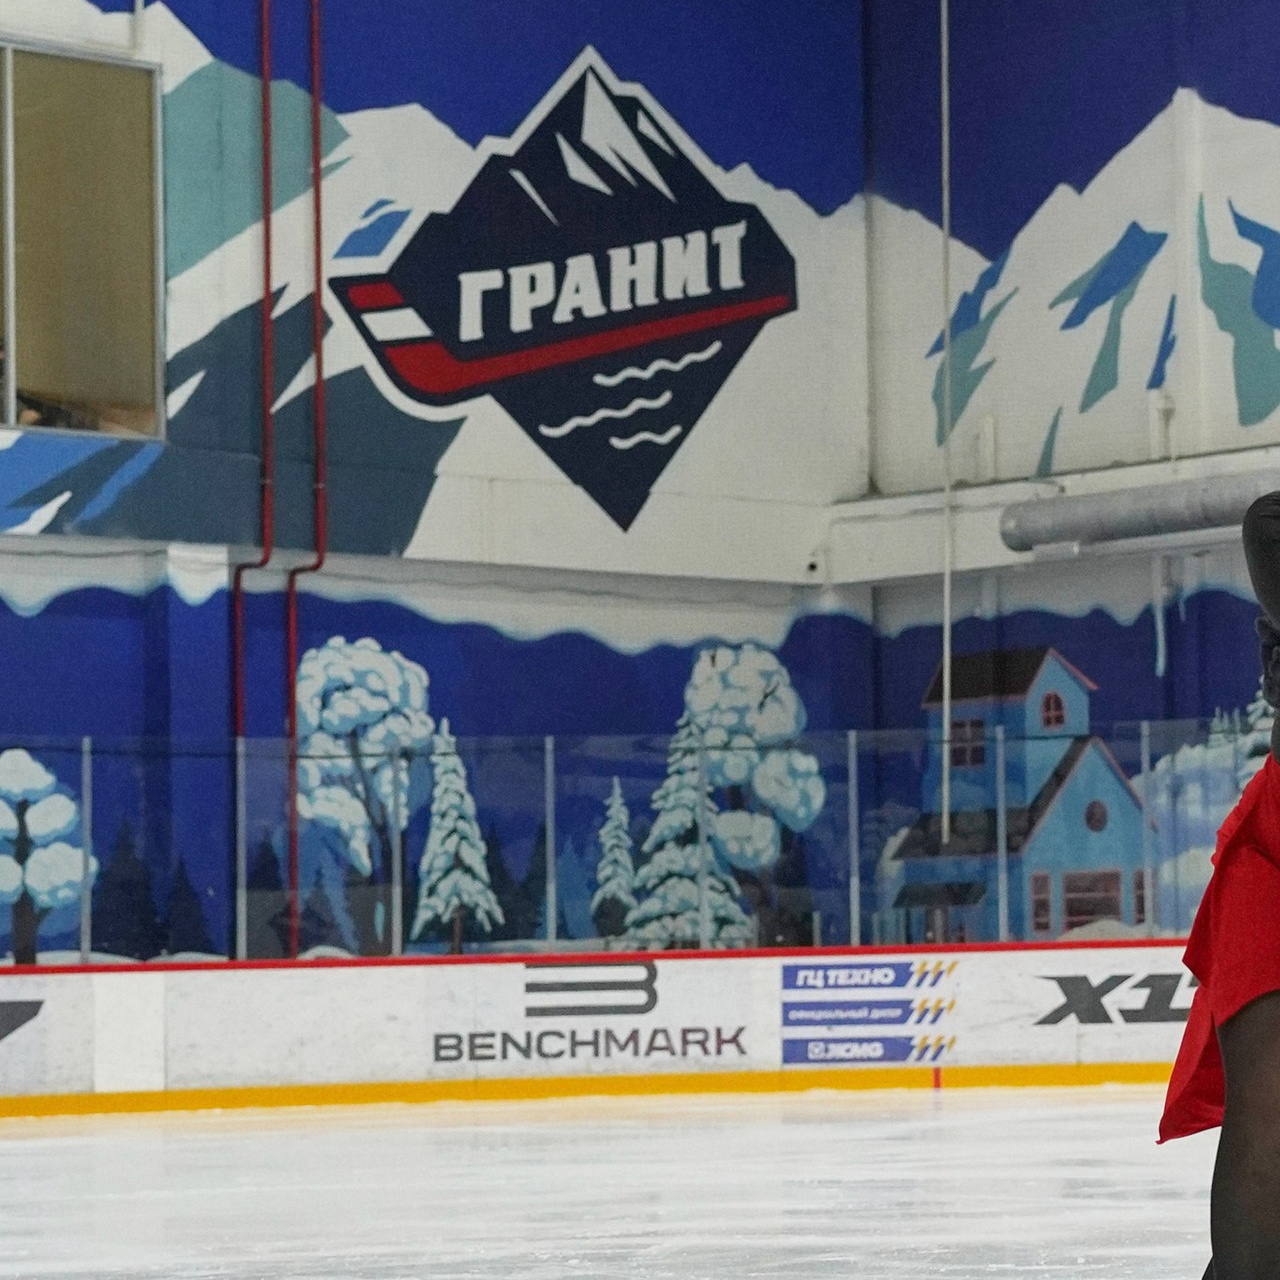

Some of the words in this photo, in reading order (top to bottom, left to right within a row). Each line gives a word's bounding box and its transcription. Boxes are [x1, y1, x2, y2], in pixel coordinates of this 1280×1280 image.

[457, 220, 747, 342] ГРАНИТ
[826, 967, 896, 986] ТЕХНО
[1034, 973, 1201, 1025] X1
[433, 1025, 748, 1062] BENCHMARK
